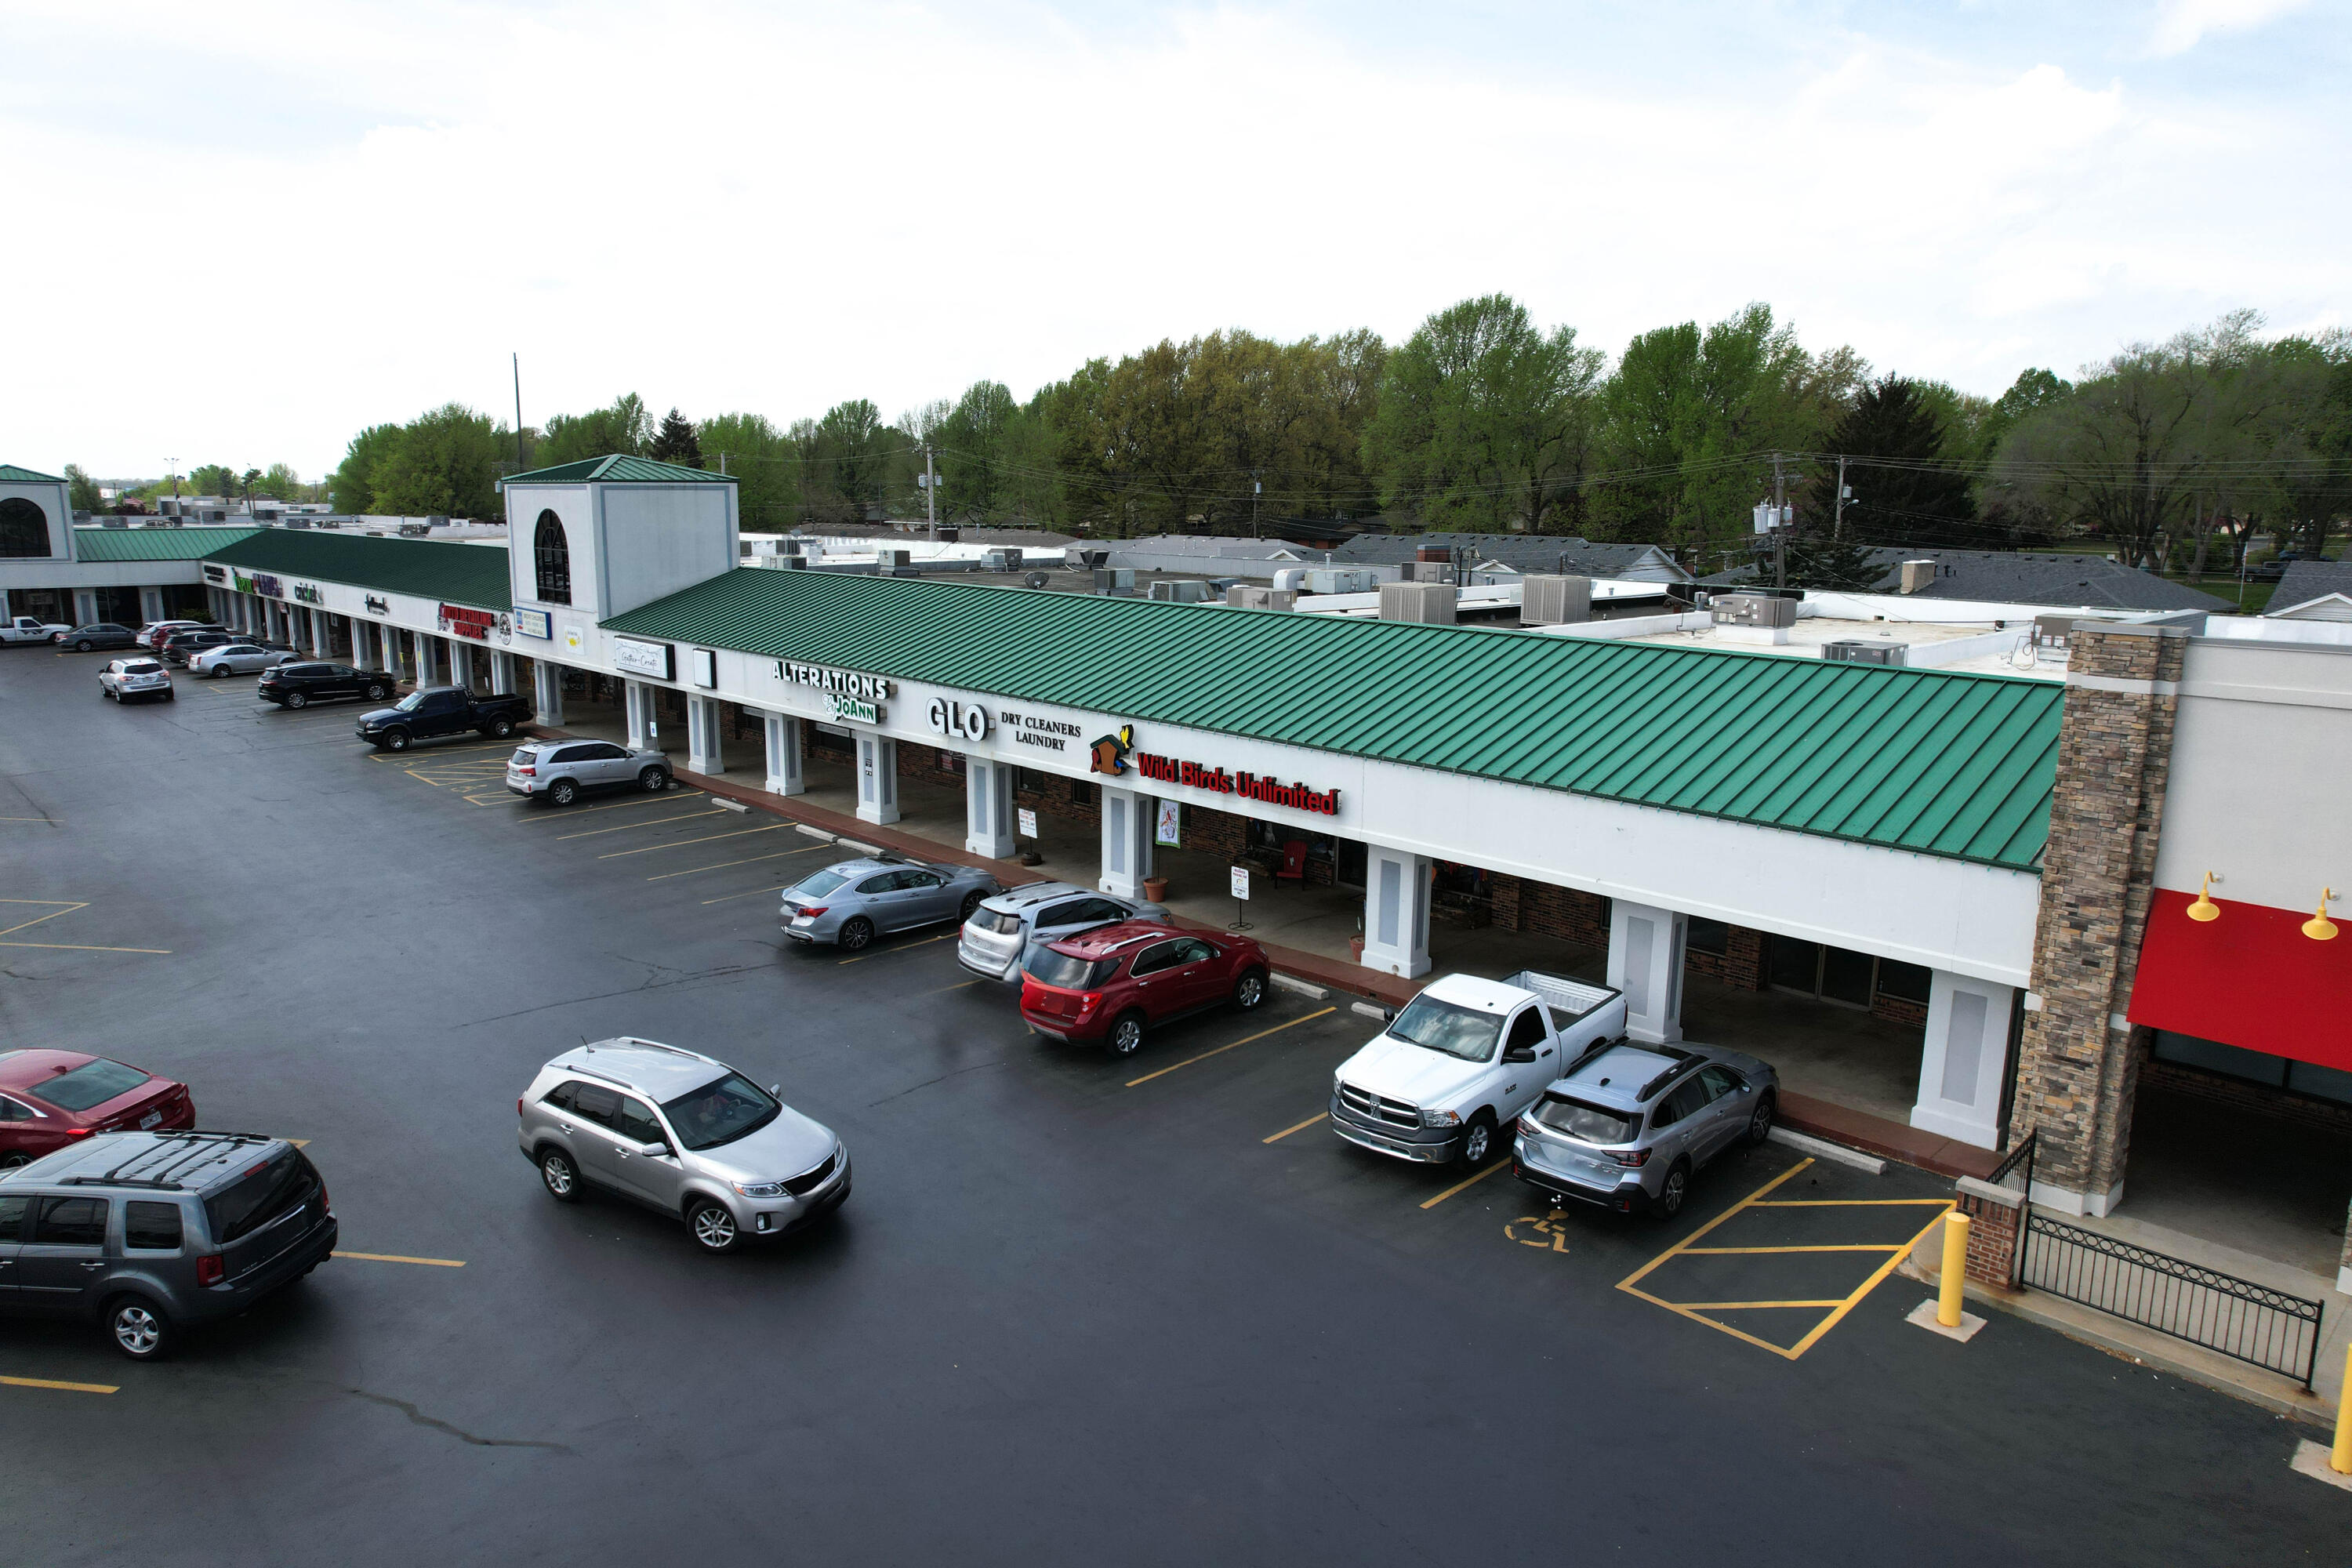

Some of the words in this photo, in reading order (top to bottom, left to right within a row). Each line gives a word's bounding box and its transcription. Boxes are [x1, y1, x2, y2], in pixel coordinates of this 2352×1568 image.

[772, 662, 888, 699] ALTERATIONS
[926, 698, 986, 742] GLO
[1001, 712, 1022, 725] DRY
[1025, 717, 1081, 737] CLEANERS
[1016, 731, 1065, 750] LAUNDRY
[1138, 753, 1178, 782] Wild
[1181, 760, 1233, 793] Birds
[1236, 771, 1338, 815] Unlimited
